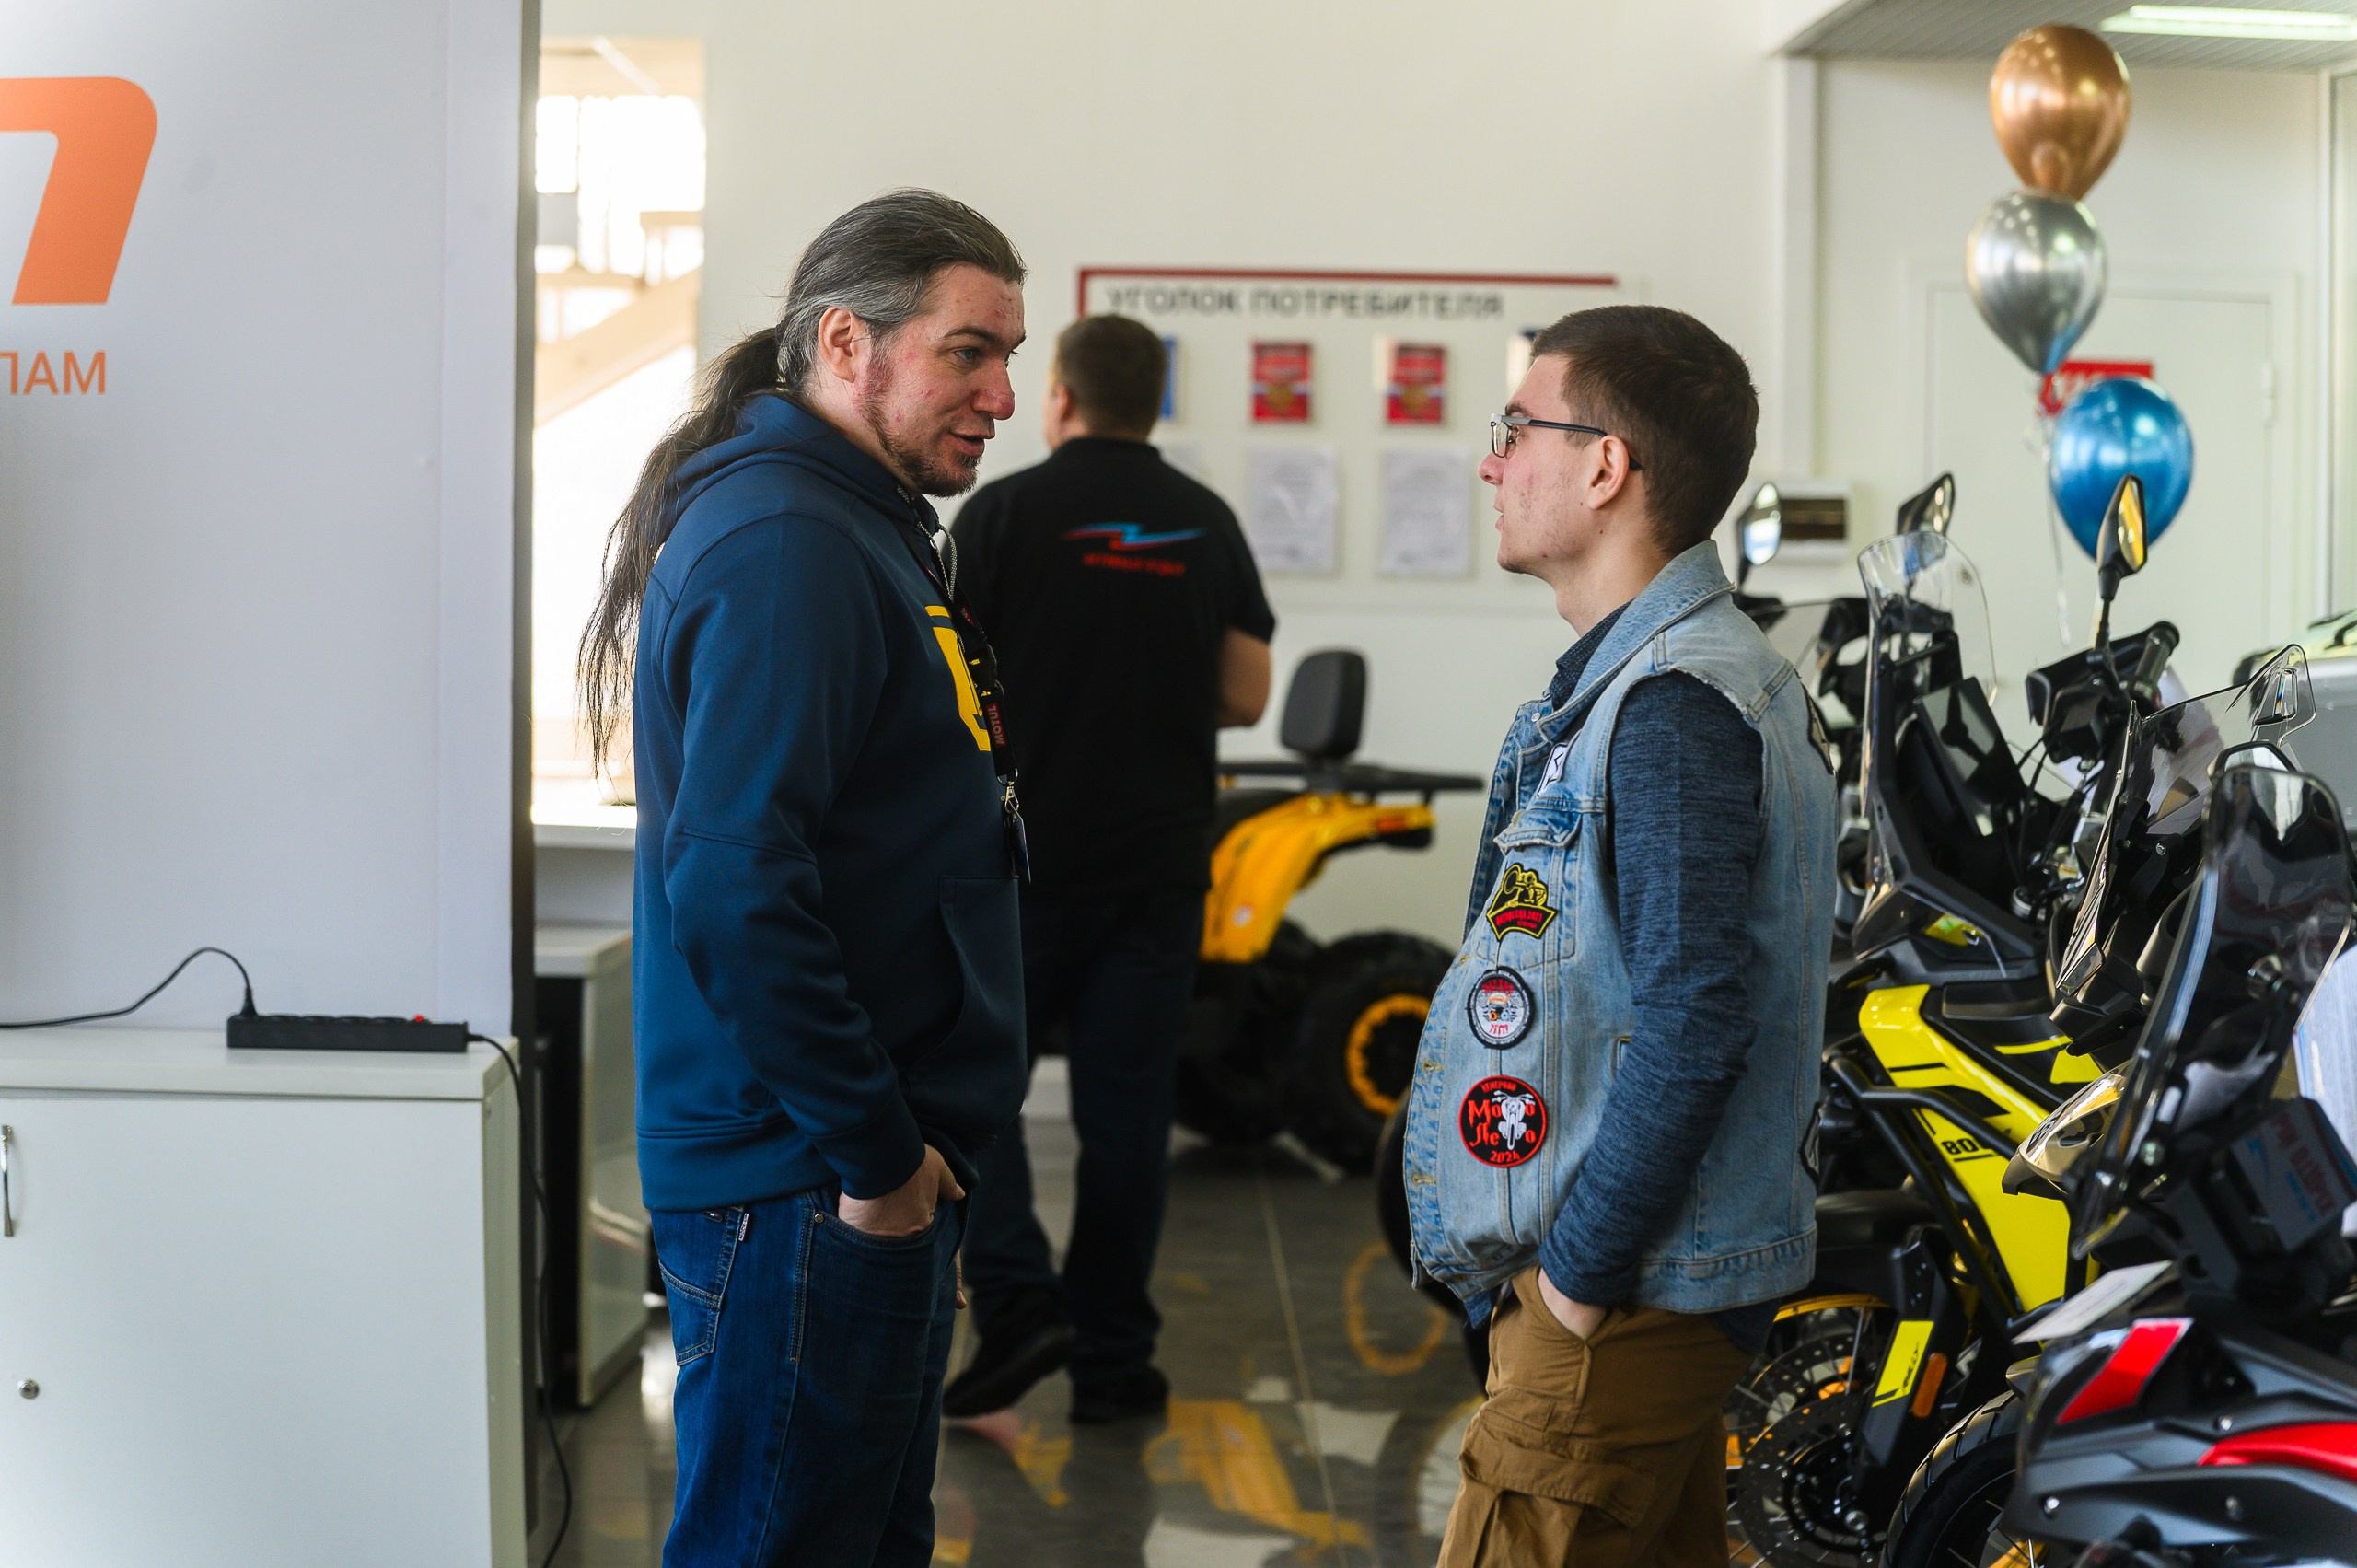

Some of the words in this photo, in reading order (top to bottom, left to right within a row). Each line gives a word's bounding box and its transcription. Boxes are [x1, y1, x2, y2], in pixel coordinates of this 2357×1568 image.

[1107, 286, 1239, 317] УГОЛОК
[1248, 289, 1505, 321] ПОТРЕБИТЕЛЯ
[987, 704, 1005, 746] MOTUL
[1490, 1150, 1522, 1164] 2024
[1941, 1138, 1992, 1155] 80
